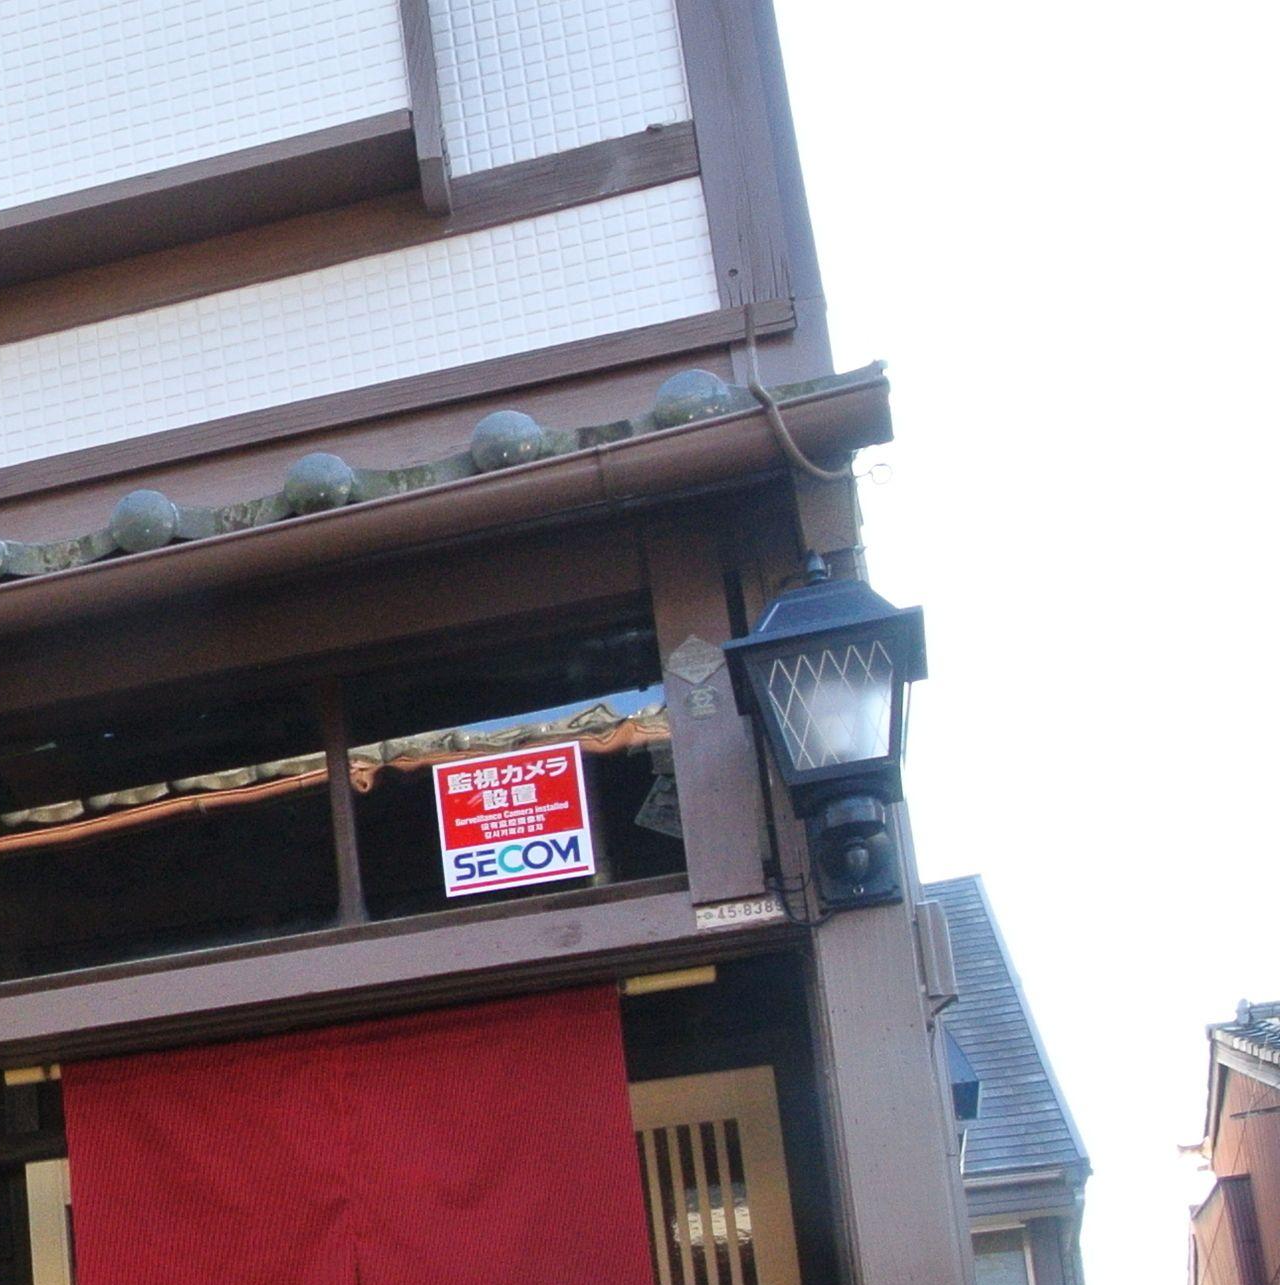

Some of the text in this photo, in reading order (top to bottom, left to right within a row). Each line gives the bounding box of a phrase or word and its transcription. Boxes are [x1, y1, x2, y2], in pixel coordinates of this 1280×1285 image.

[447, 756, 568, 794] 監視カメラ
[482, 783, 537, 810] 設置
[503, 807, 534, 819] Camera
[453, 835, 581, 881] SECOM
